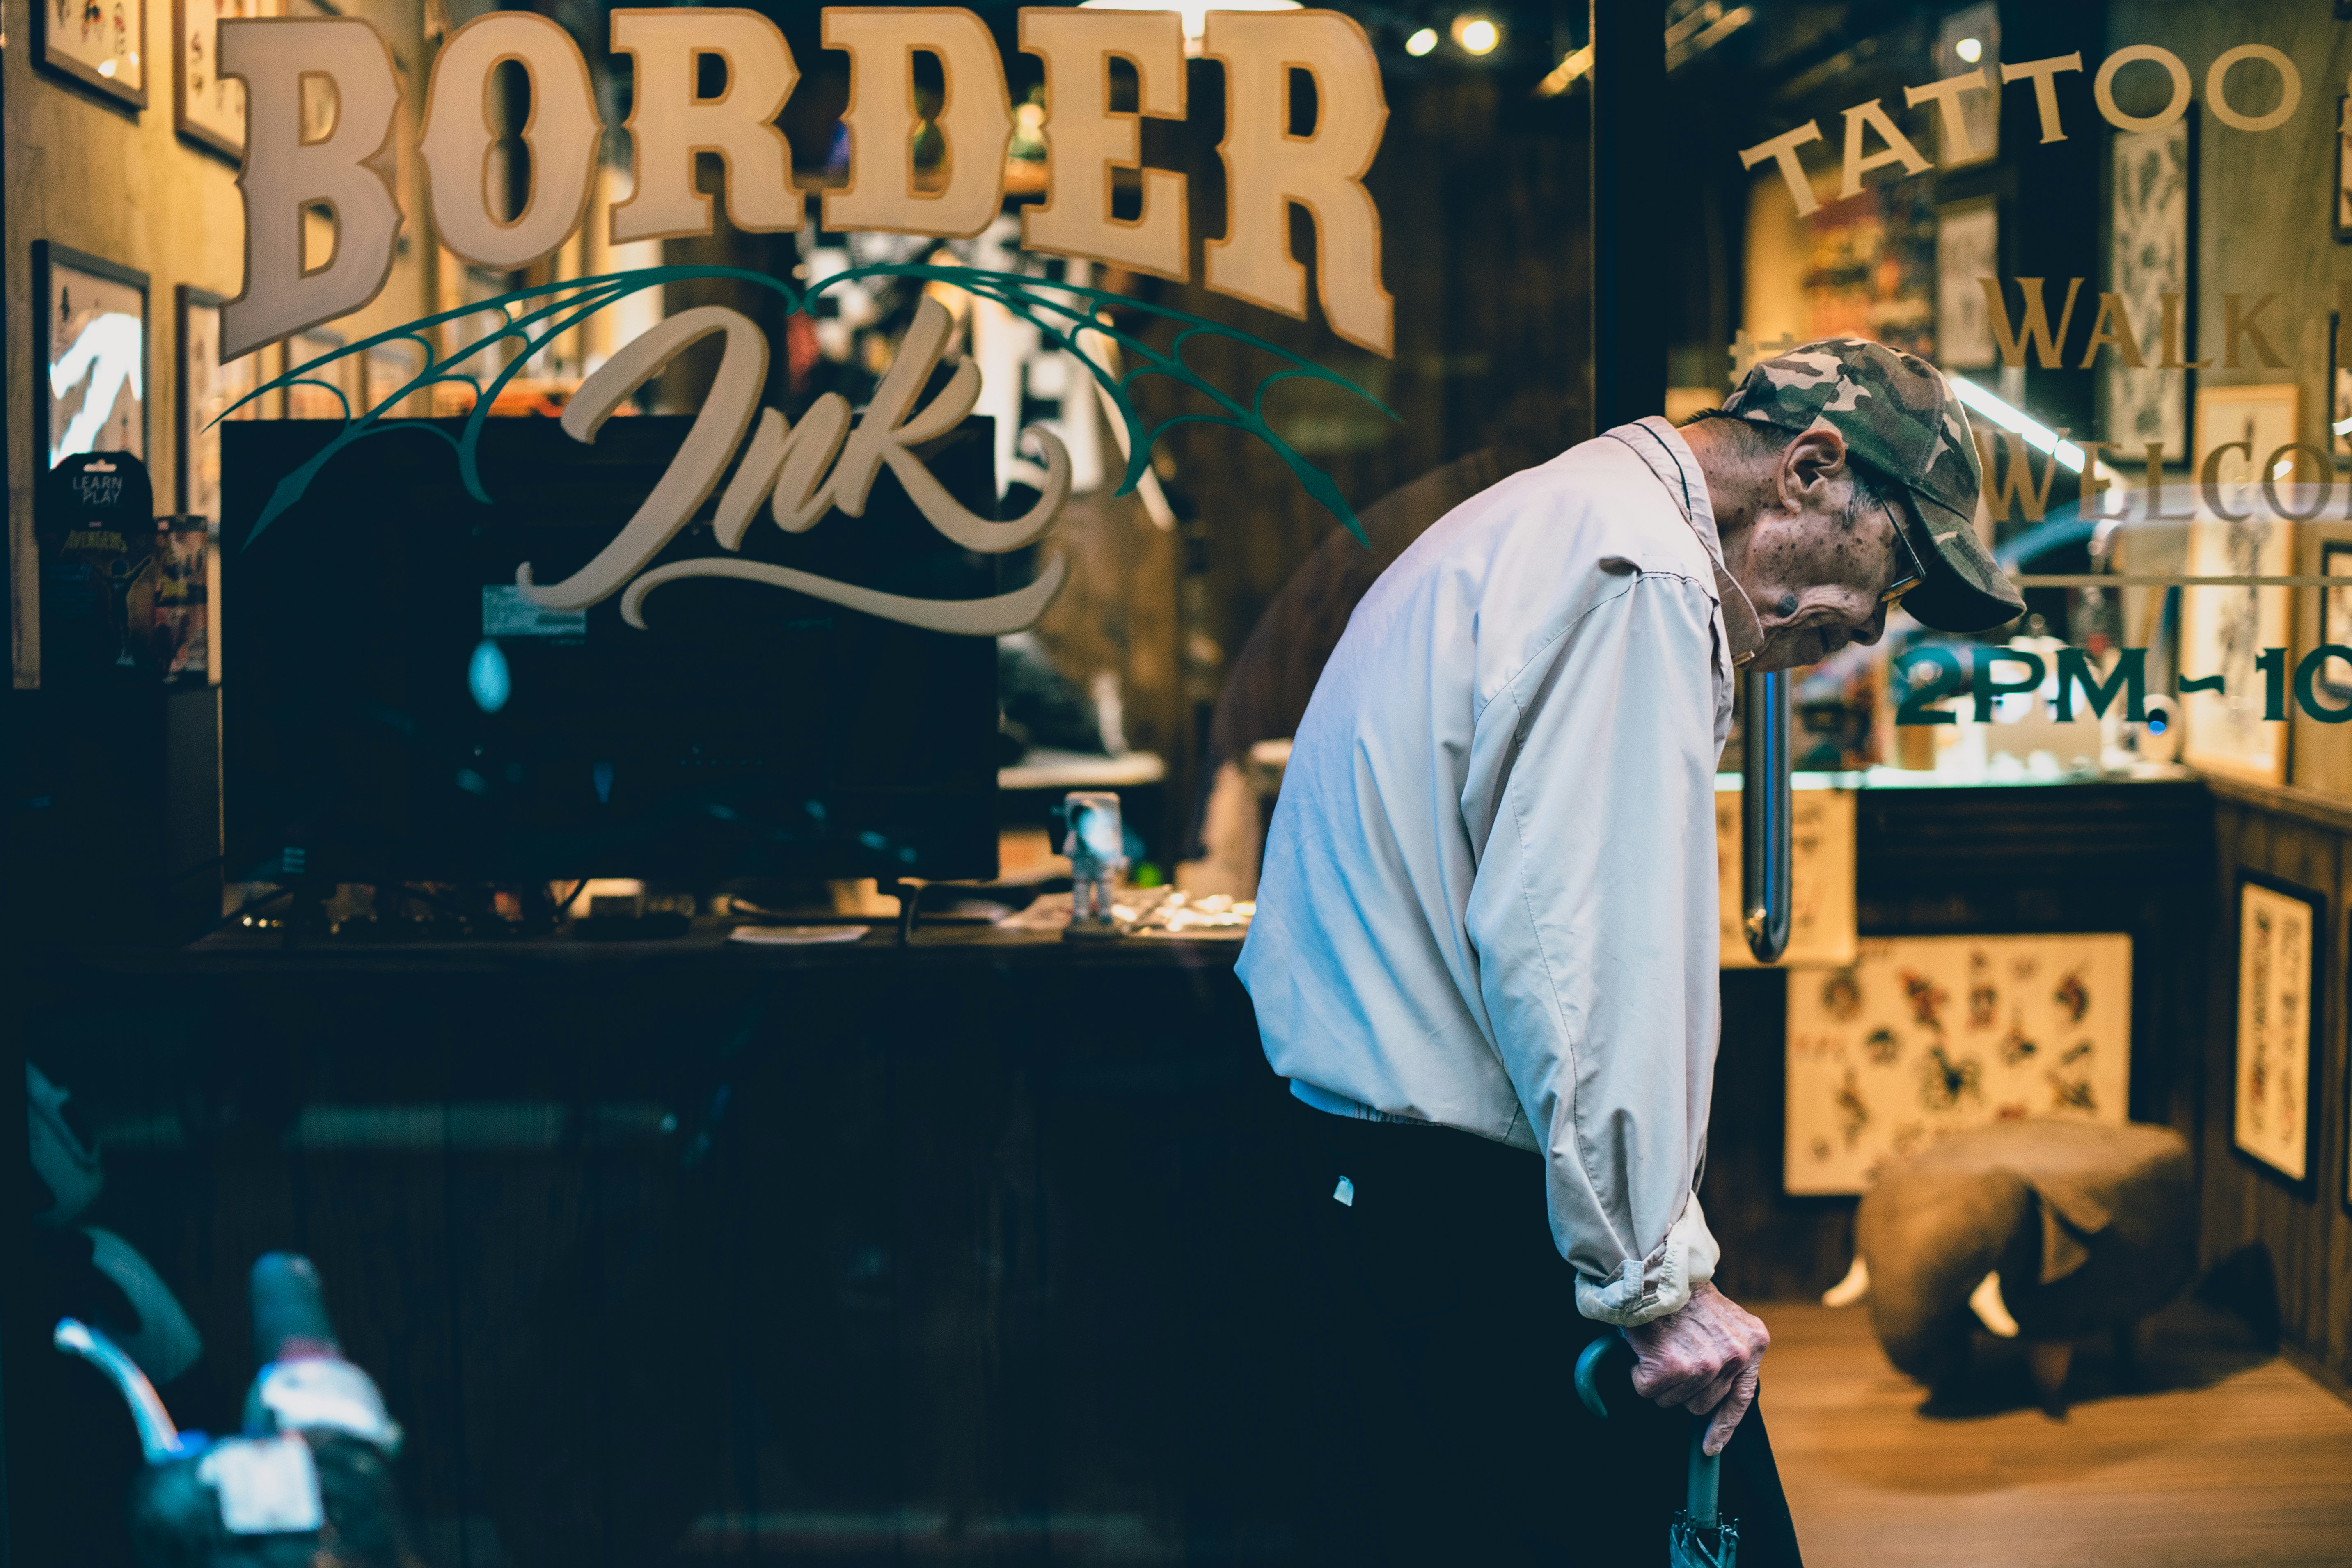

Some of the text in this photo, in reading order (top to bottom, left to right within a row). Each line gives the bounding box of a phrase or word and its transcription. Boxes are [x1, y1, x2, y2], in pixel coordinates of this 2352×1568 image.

[1738, 44, 2302, 218] TATTOO
[218, 6, 1395, 365] BORDER
[1978, 277, 2289, 369] WALK
[73, 475, 123, 491] LEARN
[82, 488, 122, 505] PLAY
[516, 294, 1072, 616] Ink
[1970, 427, 2352, 520] WELCO
